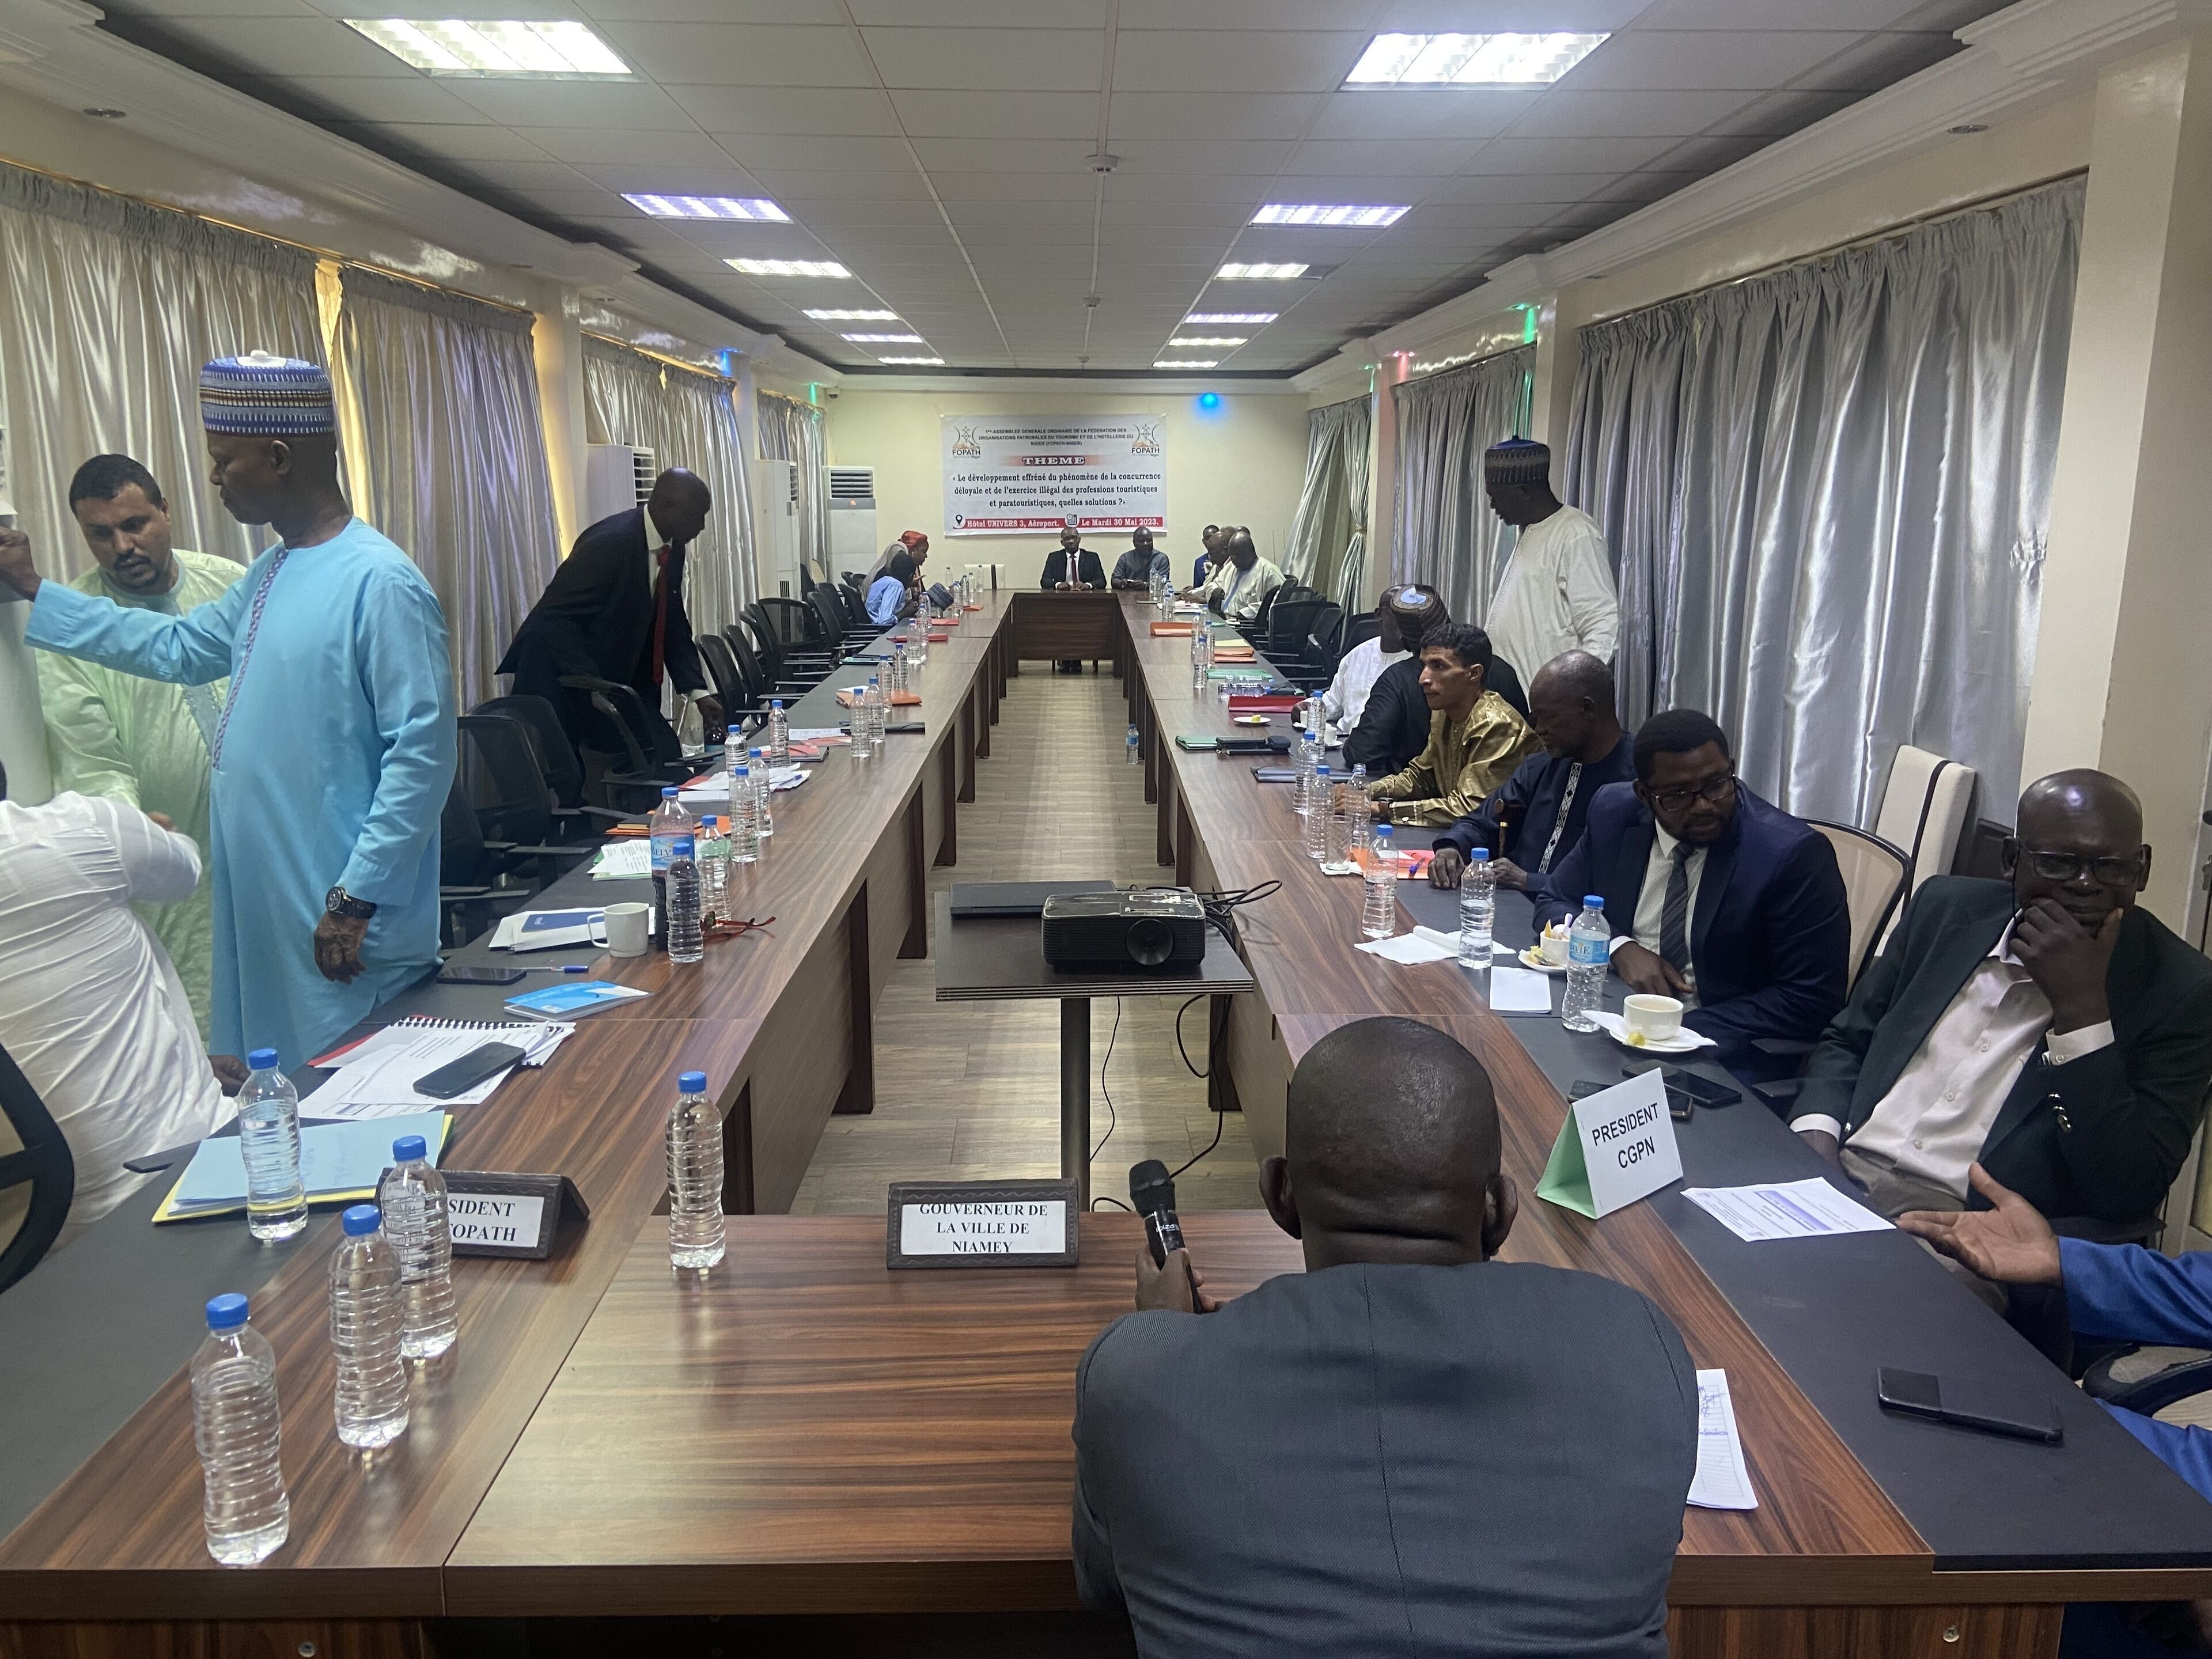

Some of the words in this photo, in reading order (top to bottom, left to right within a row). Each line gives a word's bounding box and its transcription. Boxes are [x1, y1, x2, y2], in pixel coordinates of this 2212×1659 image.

[1022, 457, 1085, 466] THEME
[968, 474, 1020, 483] développement
[1059, 472, 1098, 482] phénomène
[955, 487, 983, 496] déloyale
[1039, 487, 1060, 495] illégal
[1076, 486, 1115, 495] professions
[1116, 486, 1158, 494] touristiques
[998, 499, 1057, 509] paratouristiques,
[1059, 499, 1083, 508] quelles
[1085, 498, 1116, 506] solutions
[1020, 520, 1027, 528] 3,
[1028, 519, 1060, 528] Aéroport.
[1139, 517, 1159, 525] 2023.
[1592, 1103, 1658, 1146] PRESIDENT
[1618, 1136, 1656, 1169] CGPN
[449, 1199, 515, 1217] SIDENT
[919, 1203, 1024, 1216] GOUVERNEUR
[1028, 1204, 1048, 1216] DE
[937, 1222, 956, 1234] LA
[961, 1222, 1005, 1234] VILLE
[1010, 1223, 1029, 1234] DE
[952, 1240, 1012, 1253] NIAMEY
